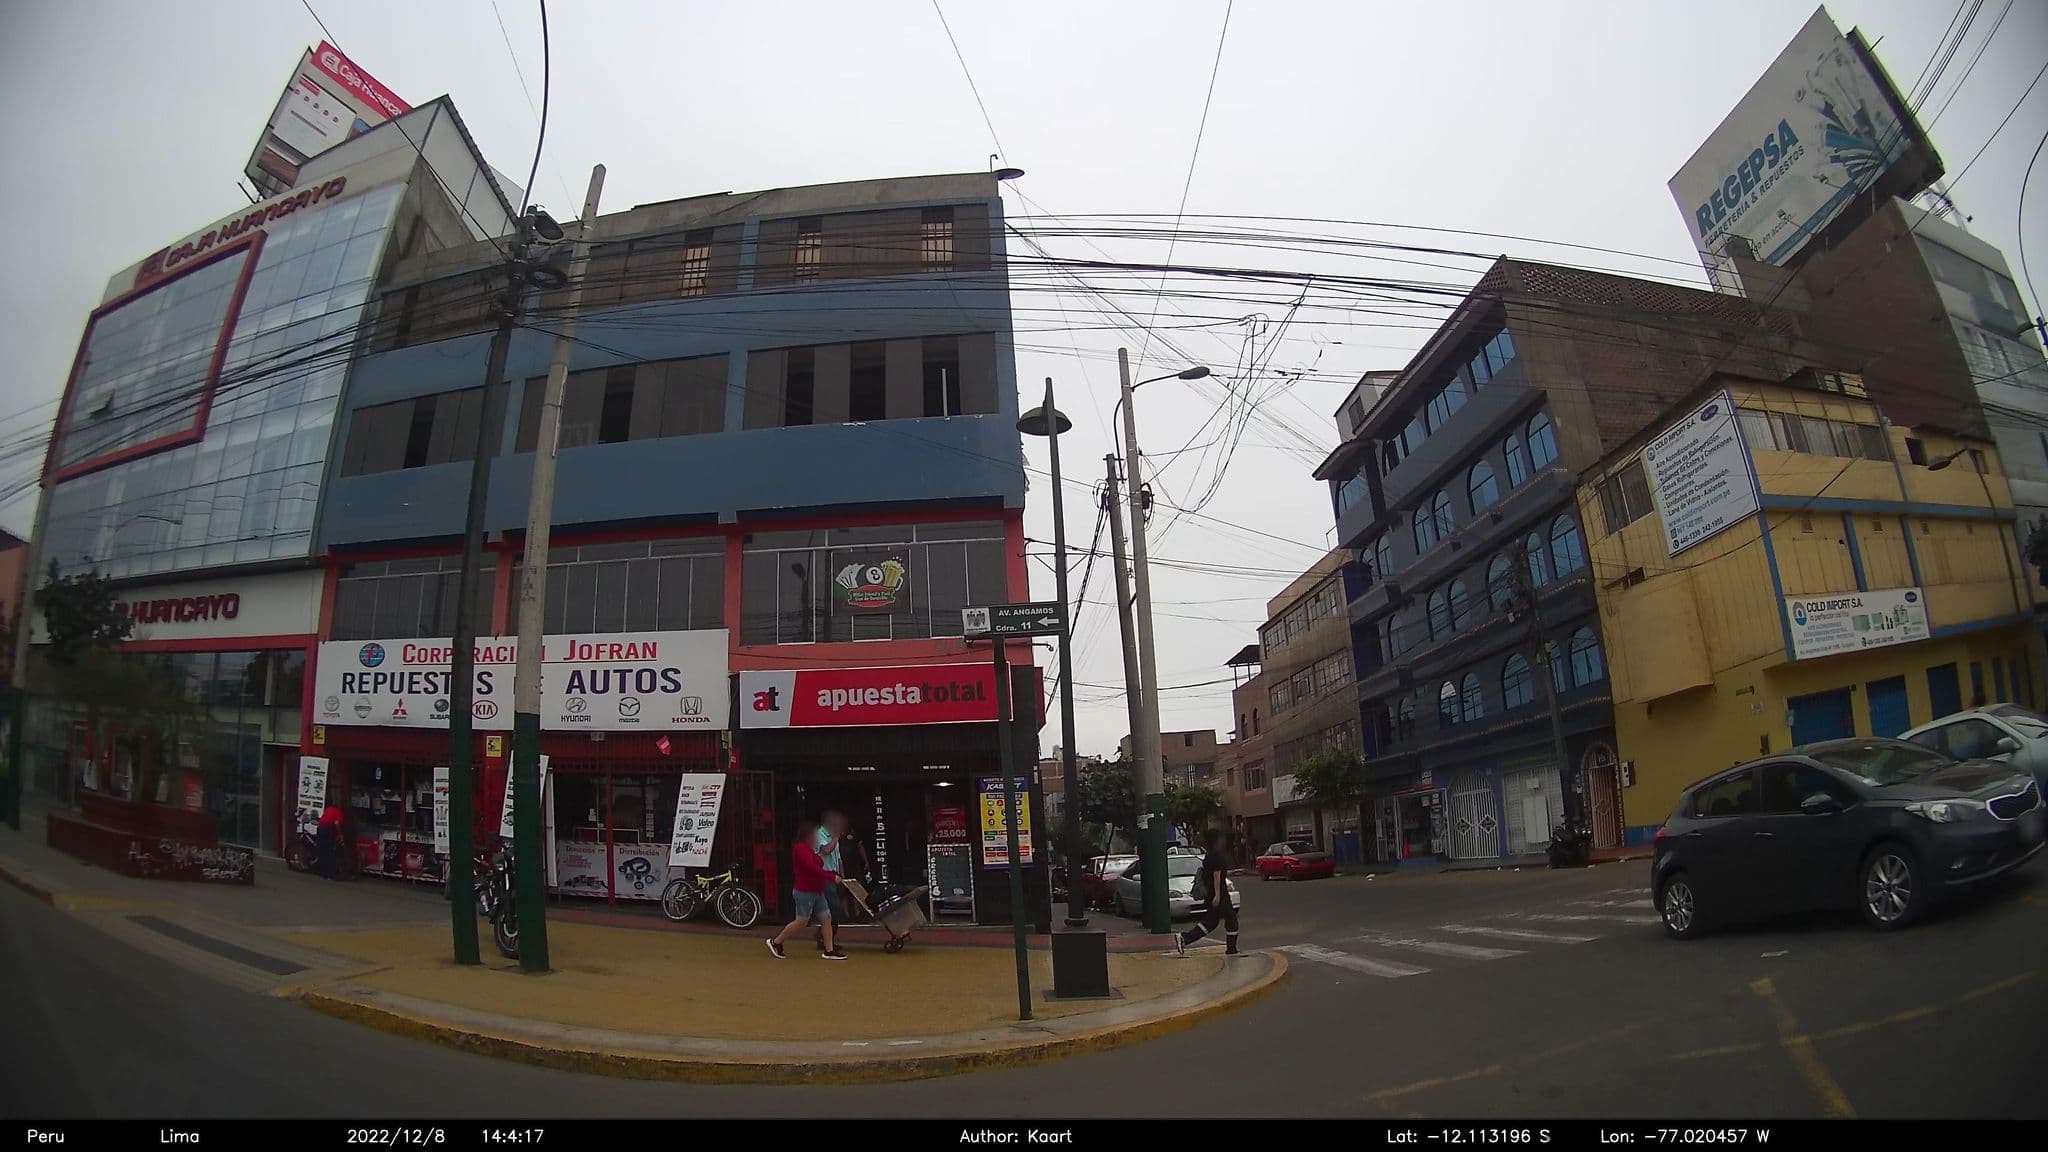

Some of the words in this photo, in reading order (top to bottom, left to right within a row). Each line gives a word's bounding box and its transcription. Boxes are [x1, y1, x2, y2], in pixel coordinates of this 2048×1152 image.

[1759, 145, 1804, 195] REPUESTOS
[1696, 119, 1799, 238] REGEPSA
[165, 231, 217, 268] CAJA
[217, 175, 347, 244] HUANCAYO
[1655, 437, 1668, 451] COLD
[870, 569, 881, 581] 8
[129, 592, 240, 625] HUANCAYO
[999, 609, 1012, 617] AV.
[1013, 607, 1054, 616] ANGAMOS
[1807, 601, 1826, 613] COLD
[1826, 599, 1851, 611] IMPORT
[1020, 621, 1032, 630] 11
[563, 639, 657, 660] JOFRAN
[341, 671, 493, 694] REPUESTS
[565, 668, 682, 694] AUTOS
[753, 686, 780, 711] at
[475, 704, 494, 716] KIA
[561, 714, 591, 723] HYUNDAI
[671, 716, 711, 724] HONDA
